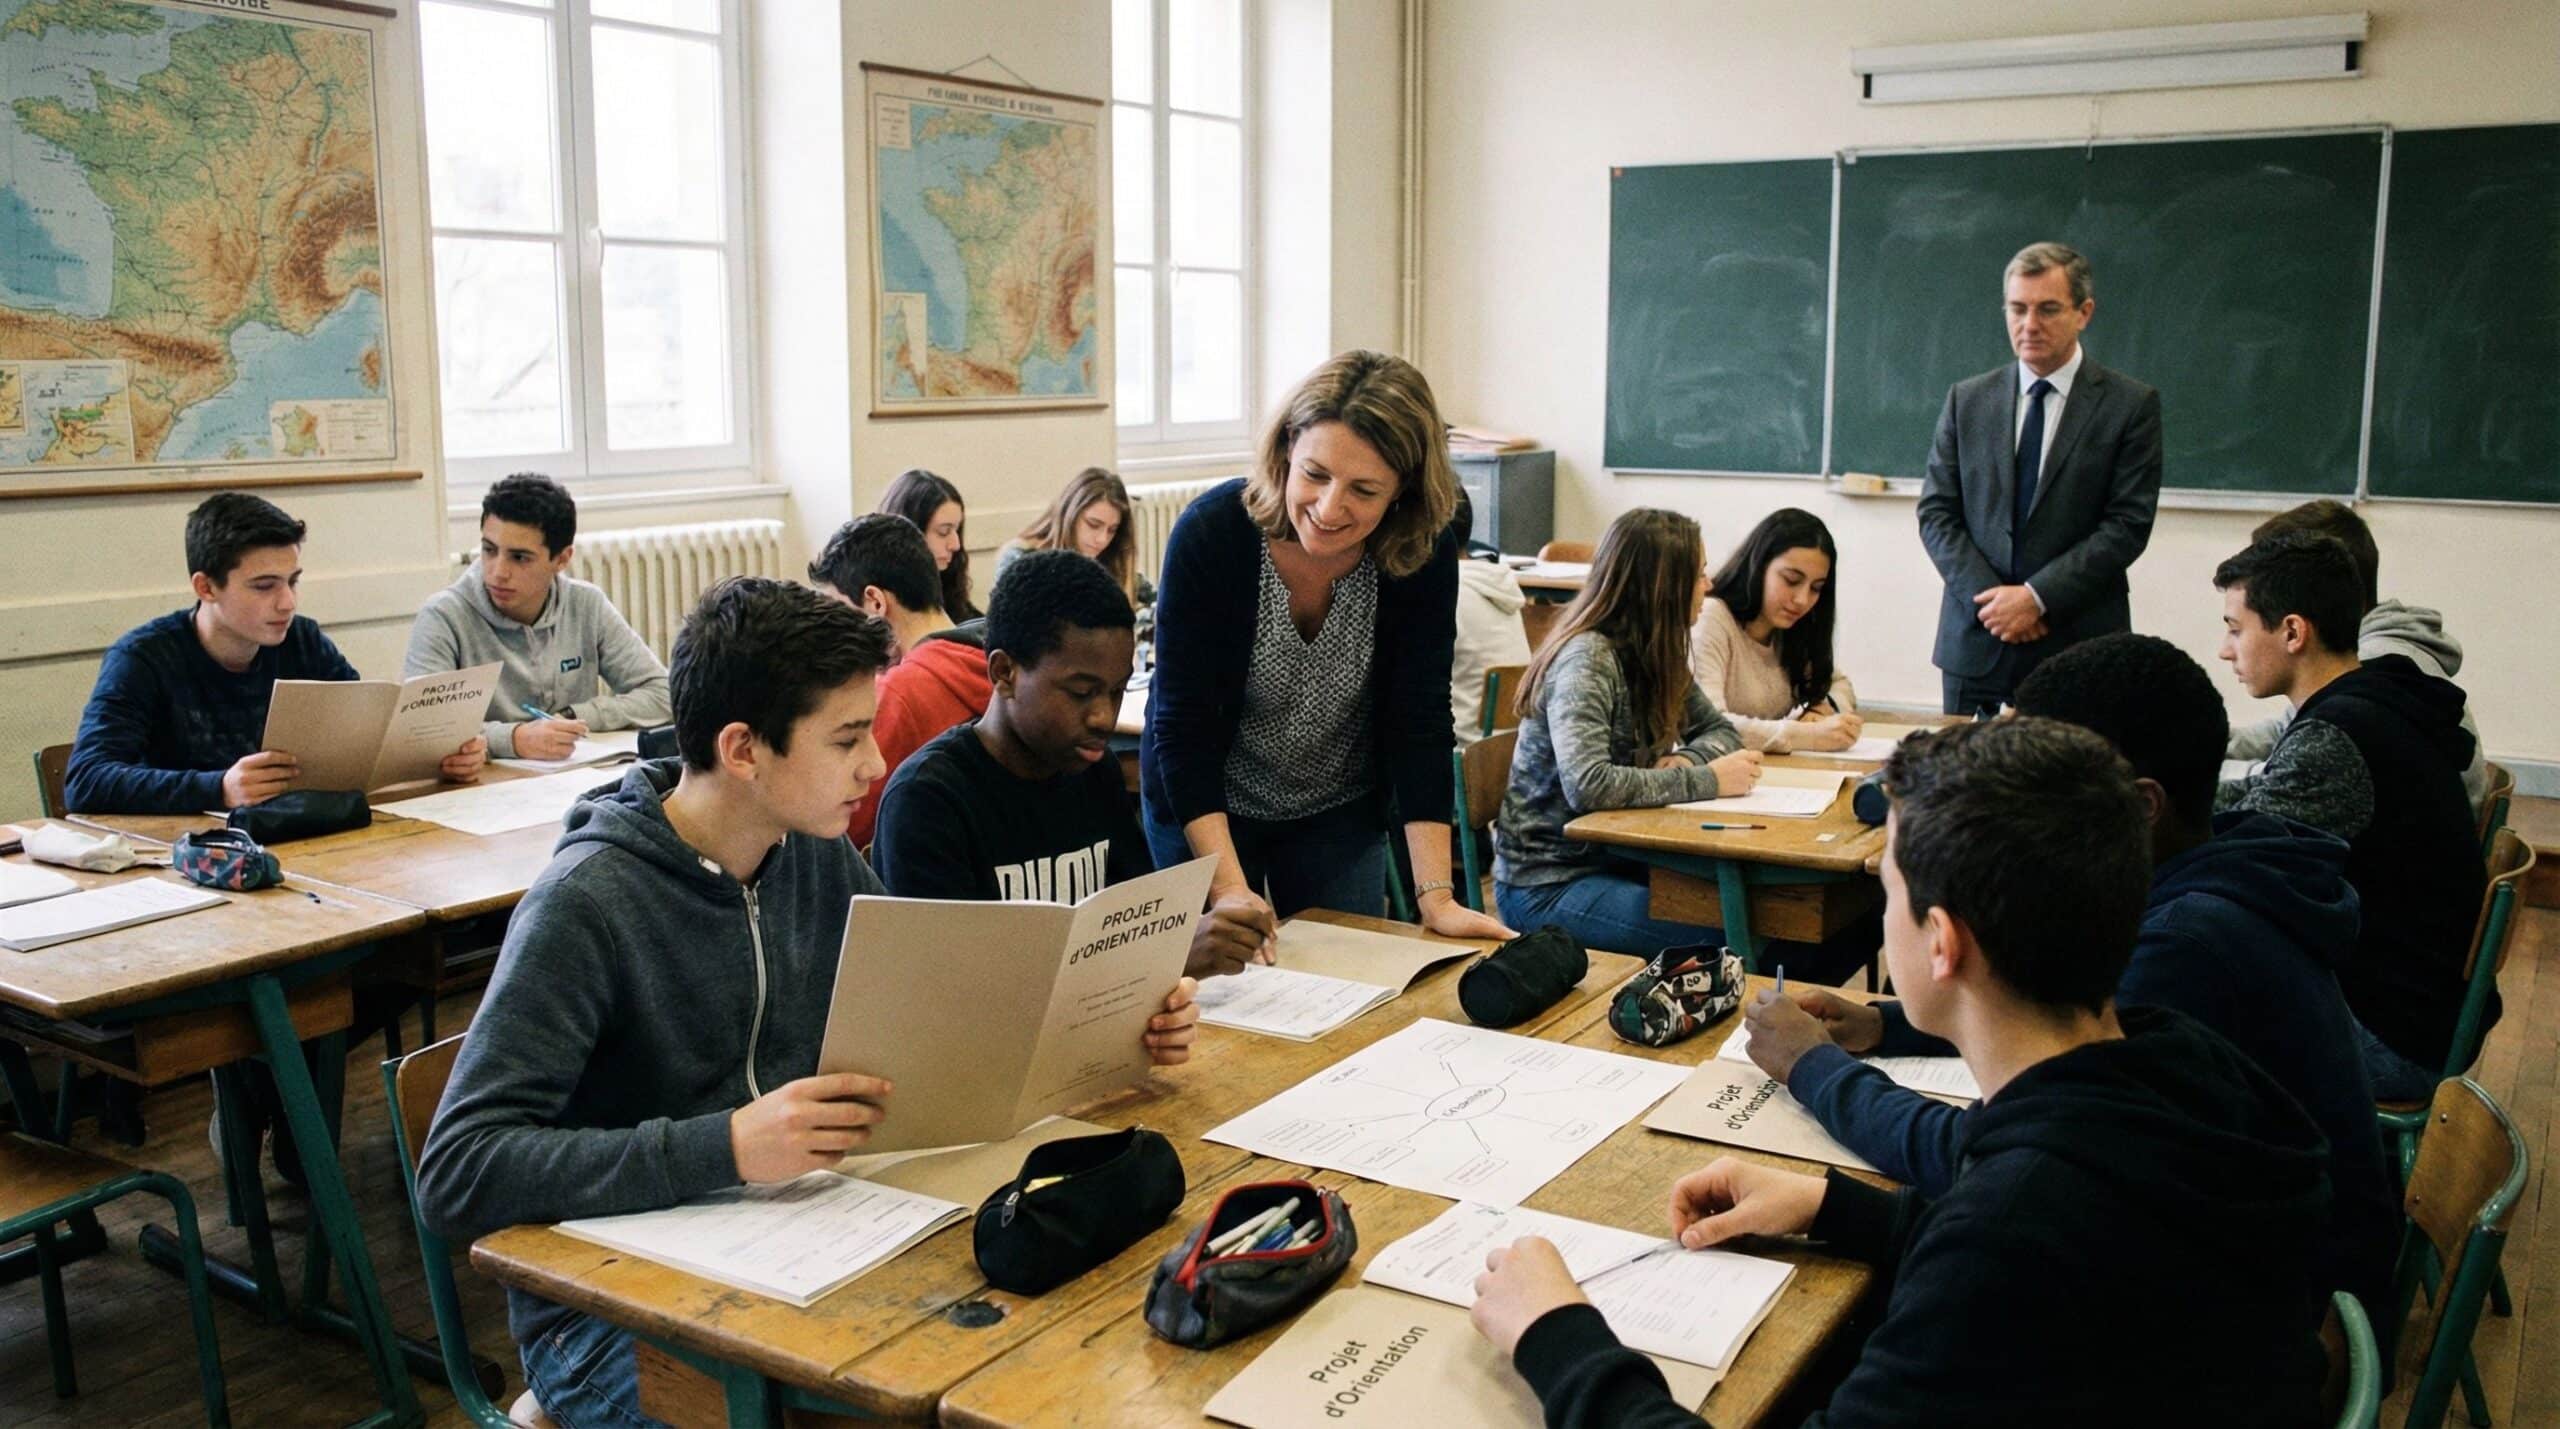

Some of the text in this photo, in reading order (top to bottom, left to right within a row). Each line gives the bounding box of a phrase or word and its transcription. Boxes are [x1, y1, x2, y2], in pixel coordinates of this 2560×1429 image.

[1101, 898, 1164, 931] PROJET
[1069, 912, 1187, 966] d'ORIENTATION
[1707, 1084, 1743, 1111] Projet
[1724, 1079, 1780, 1130] d'Orientation
[1309, 1340, 1368, 1384] Projet
[1324, 1326, 1429, 1418] d'Orientation
